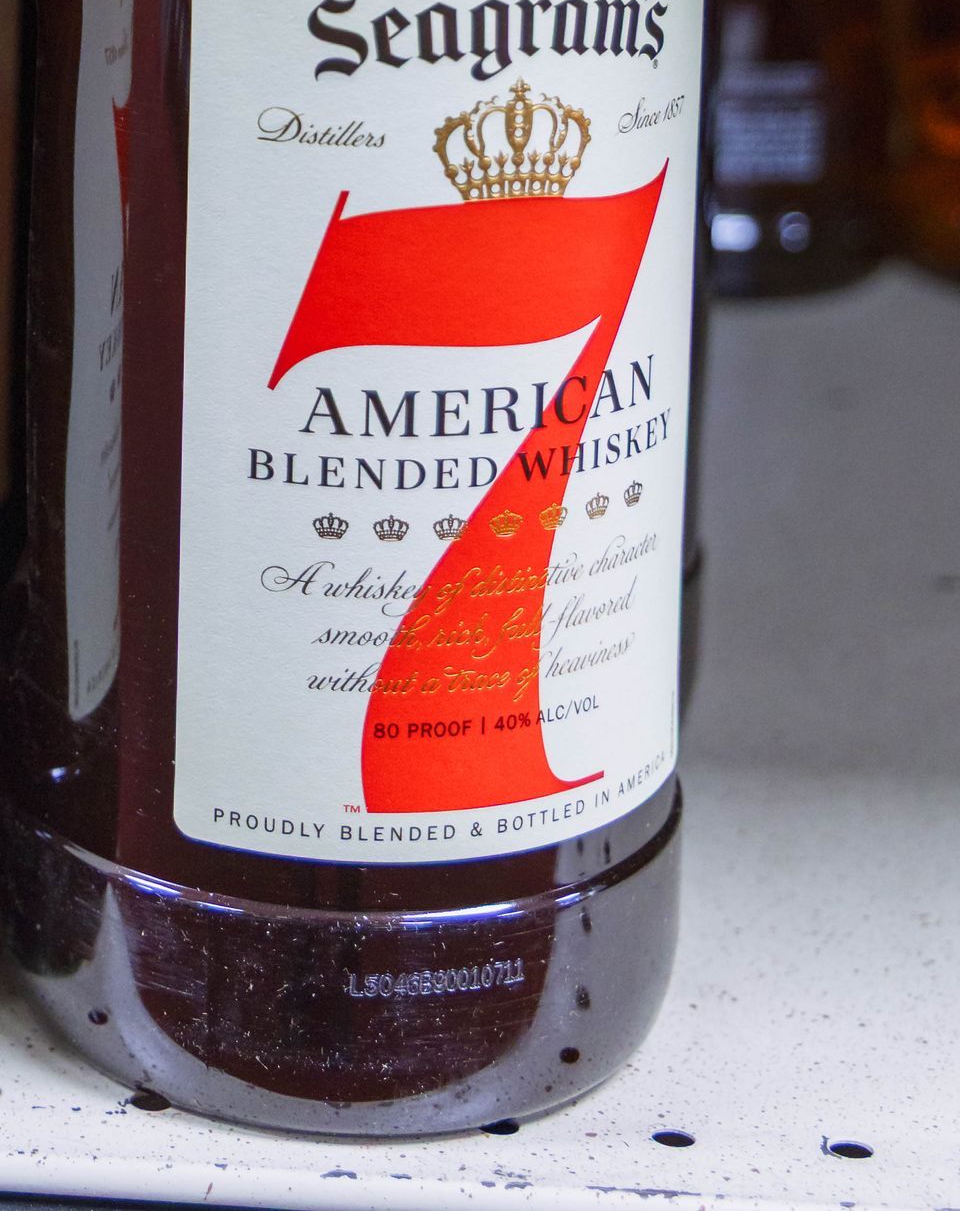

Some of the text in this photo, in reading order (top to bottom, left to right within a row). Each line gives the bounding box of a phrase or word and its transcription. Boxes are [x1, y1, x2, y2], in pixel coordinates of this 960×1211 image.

[257, 94, 685, 149] Distillers Since 1857
[298, 354, 655, 438] AMERICAN
[246, 408, 673, 490] BLENDED WHISKEY
[267, 157, 670, 814] 7
[260, 532, 659, 617] A whiskey of distinctive character
[311, 614, 431, 651] smooth,
[471, 575, 638, 659] full-flavored
[306, 662, 418, 694] without
[421, 677, 442, 695] a
[512, 650, 553, 702] of
[544, 631, 636, 678] heaviness
[373, 722, 400, 739] 80
[407, 720, 472, 738] PROOF
[494, 712, 531, 731] 40%
[536, 694, 600, 725] ALC/VOL
[214, 750, 665, 842] PROUDLY BLENDED & BOTTLED IN AMERICA
